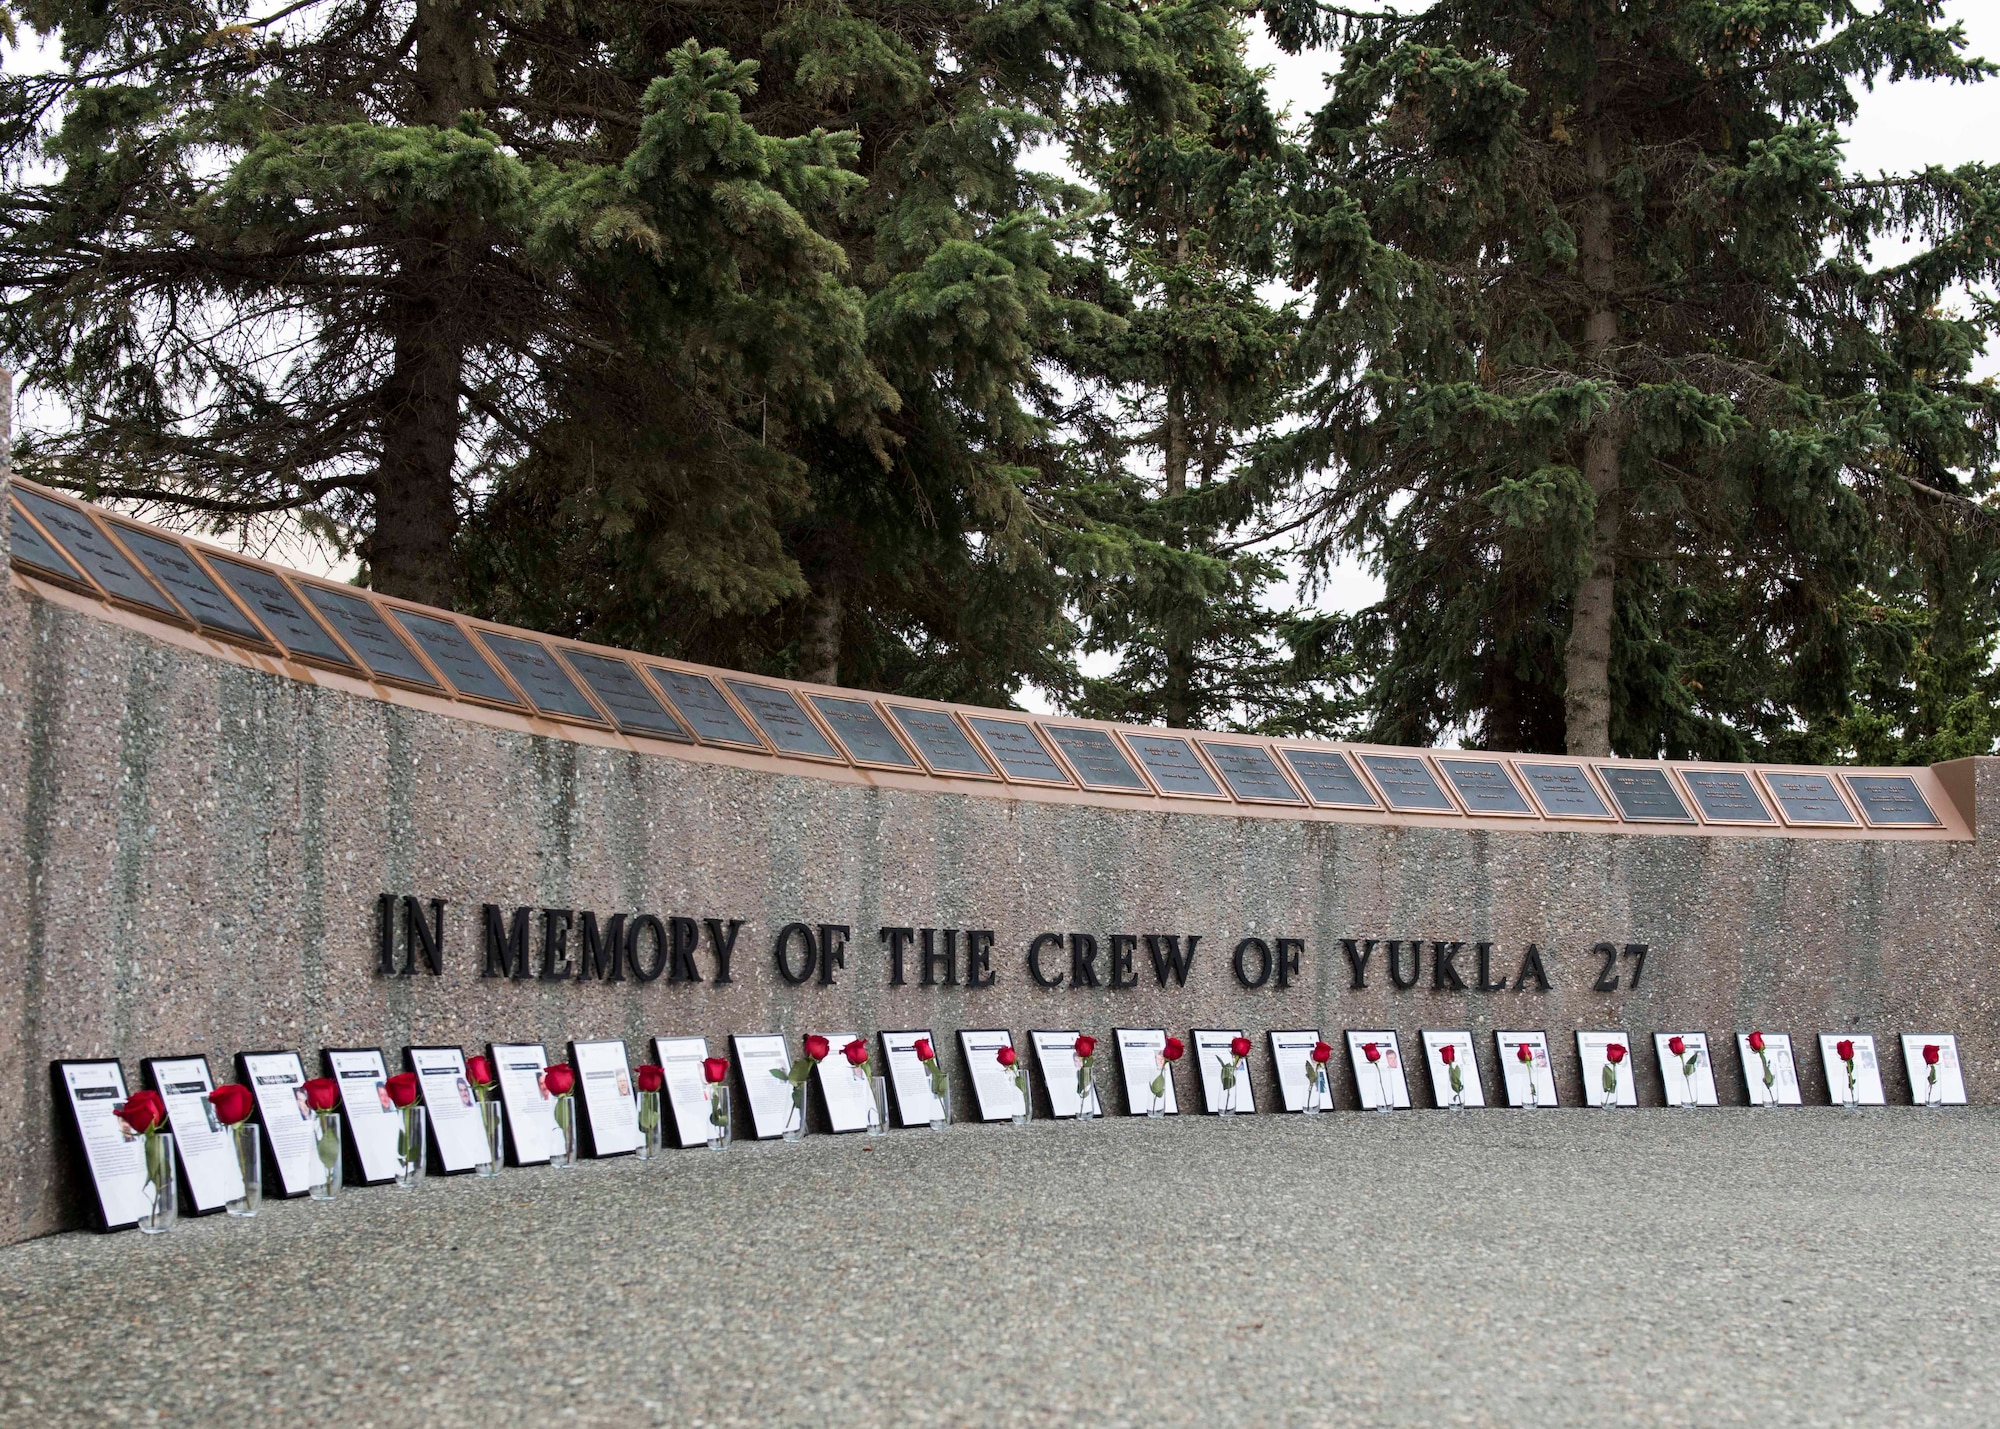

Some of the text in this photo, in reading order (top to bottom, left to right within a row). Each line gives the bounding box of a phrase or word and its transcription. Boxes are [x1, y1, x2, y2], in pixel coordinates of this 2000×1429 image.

[373, 893, 1650, 992] IN MEMORY OF THE CREW OF YUKLA 27
